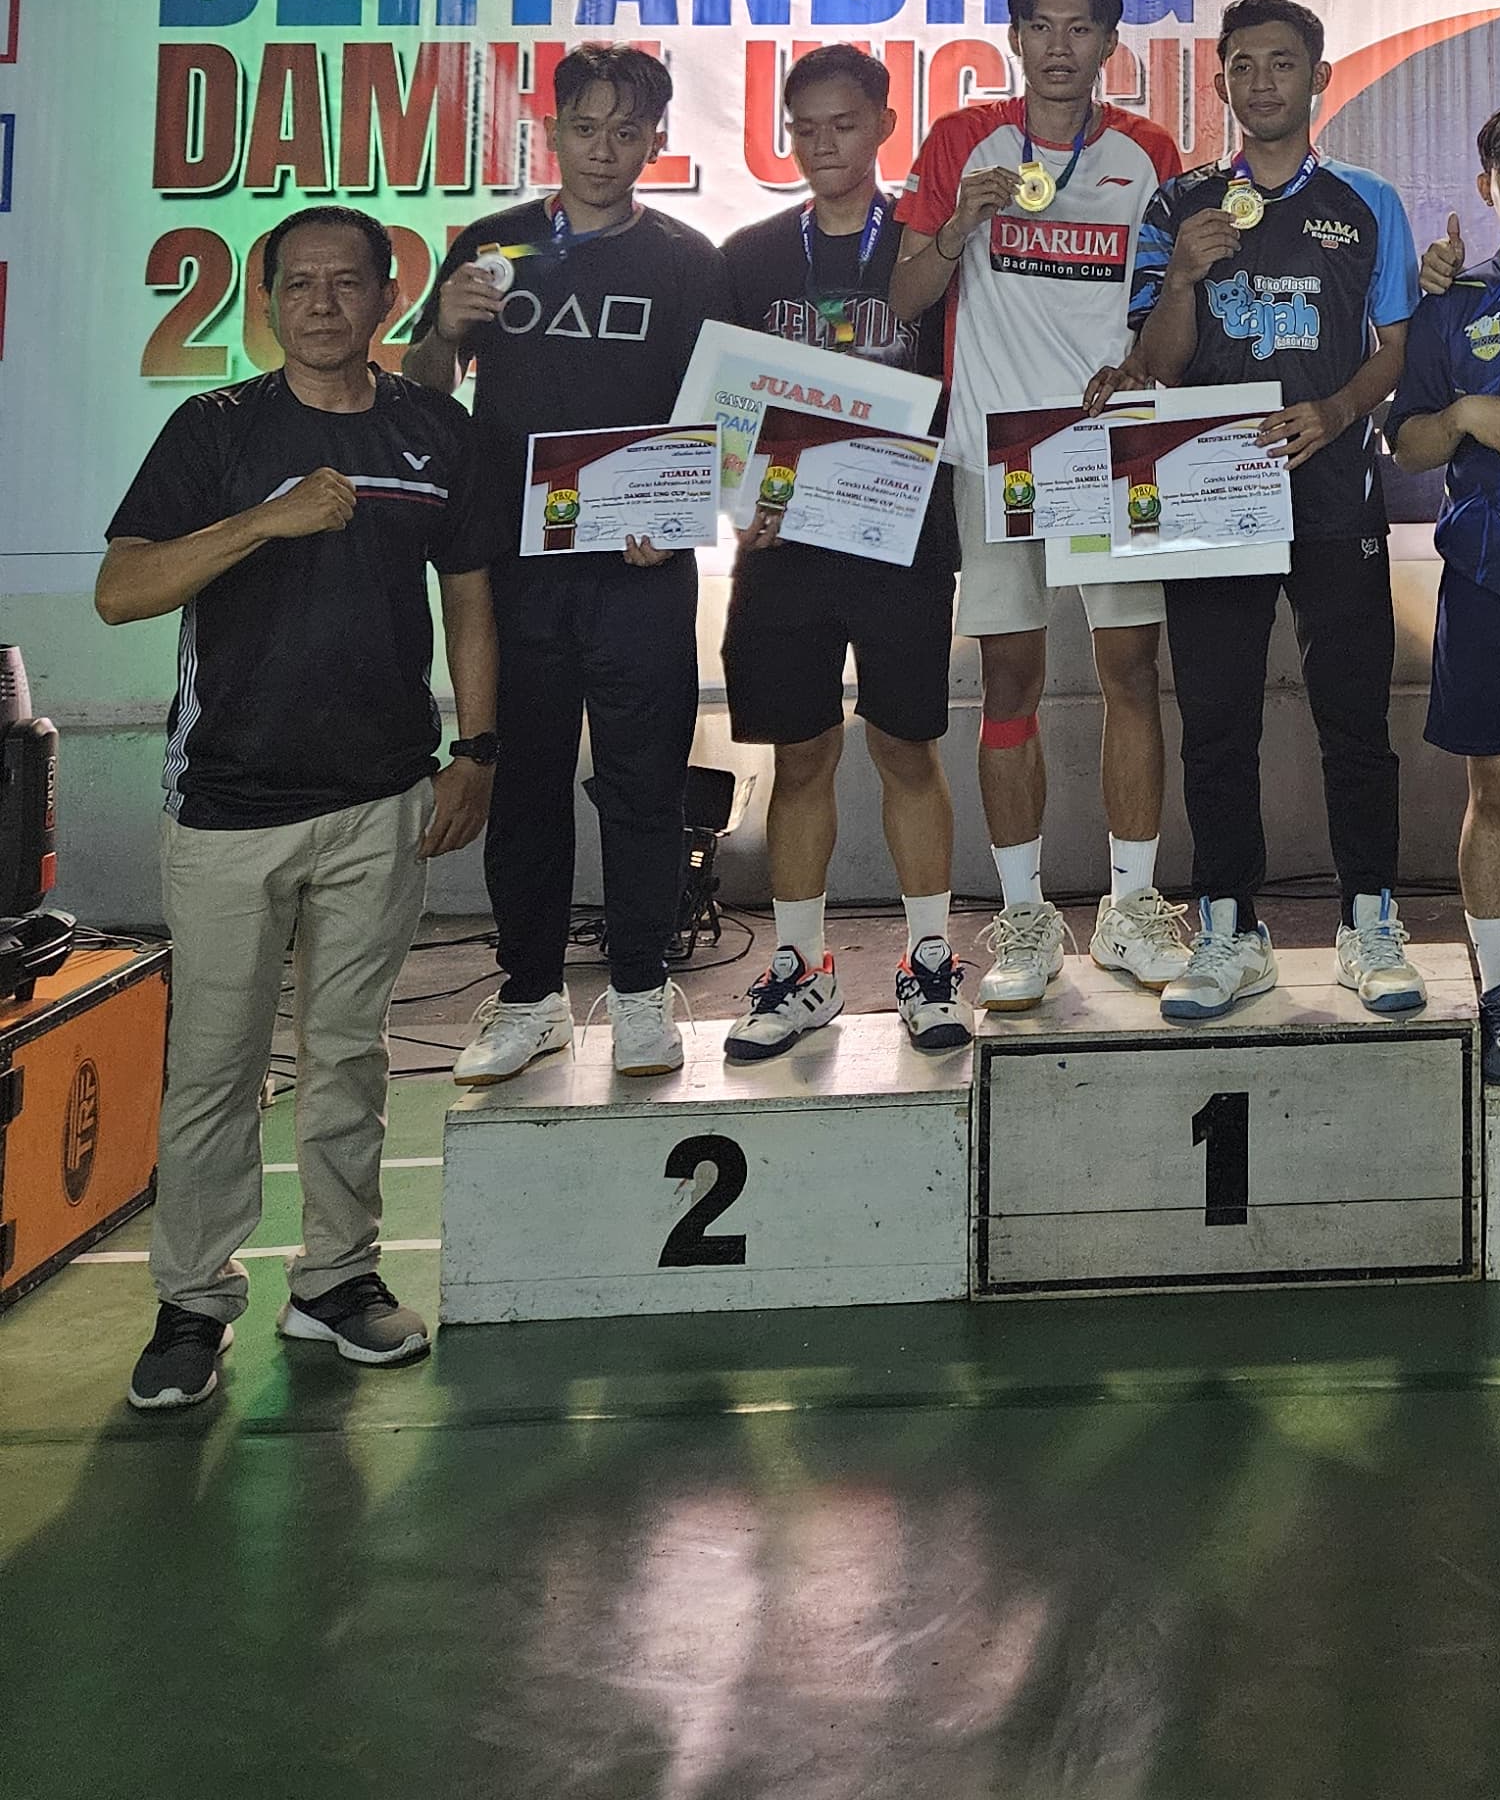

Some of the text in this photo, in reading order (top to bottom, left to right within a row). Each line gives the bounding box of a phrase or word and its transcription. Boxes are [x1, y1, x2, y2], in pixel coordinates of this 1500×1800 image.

[1001, 223, 1119, 257] DJARUM
[1302, 218, 1360, 243] AJAMA
[1002, 256, 1113, 277] Badminton Club
[1254, 276, 1320, 292] Toko Plastik
[751, 374, 873, 420] JUARA II
[659, 469, 711, 479] JUARA II
[1235, 460, 1280, 472] JUARA I
[873, 476, 910, 491] JUARA
[75, 1066, 97, 1163] TRF
[1191, 1092, 1249, 1227] 1
[658, 1133, 748, 1268] 2
